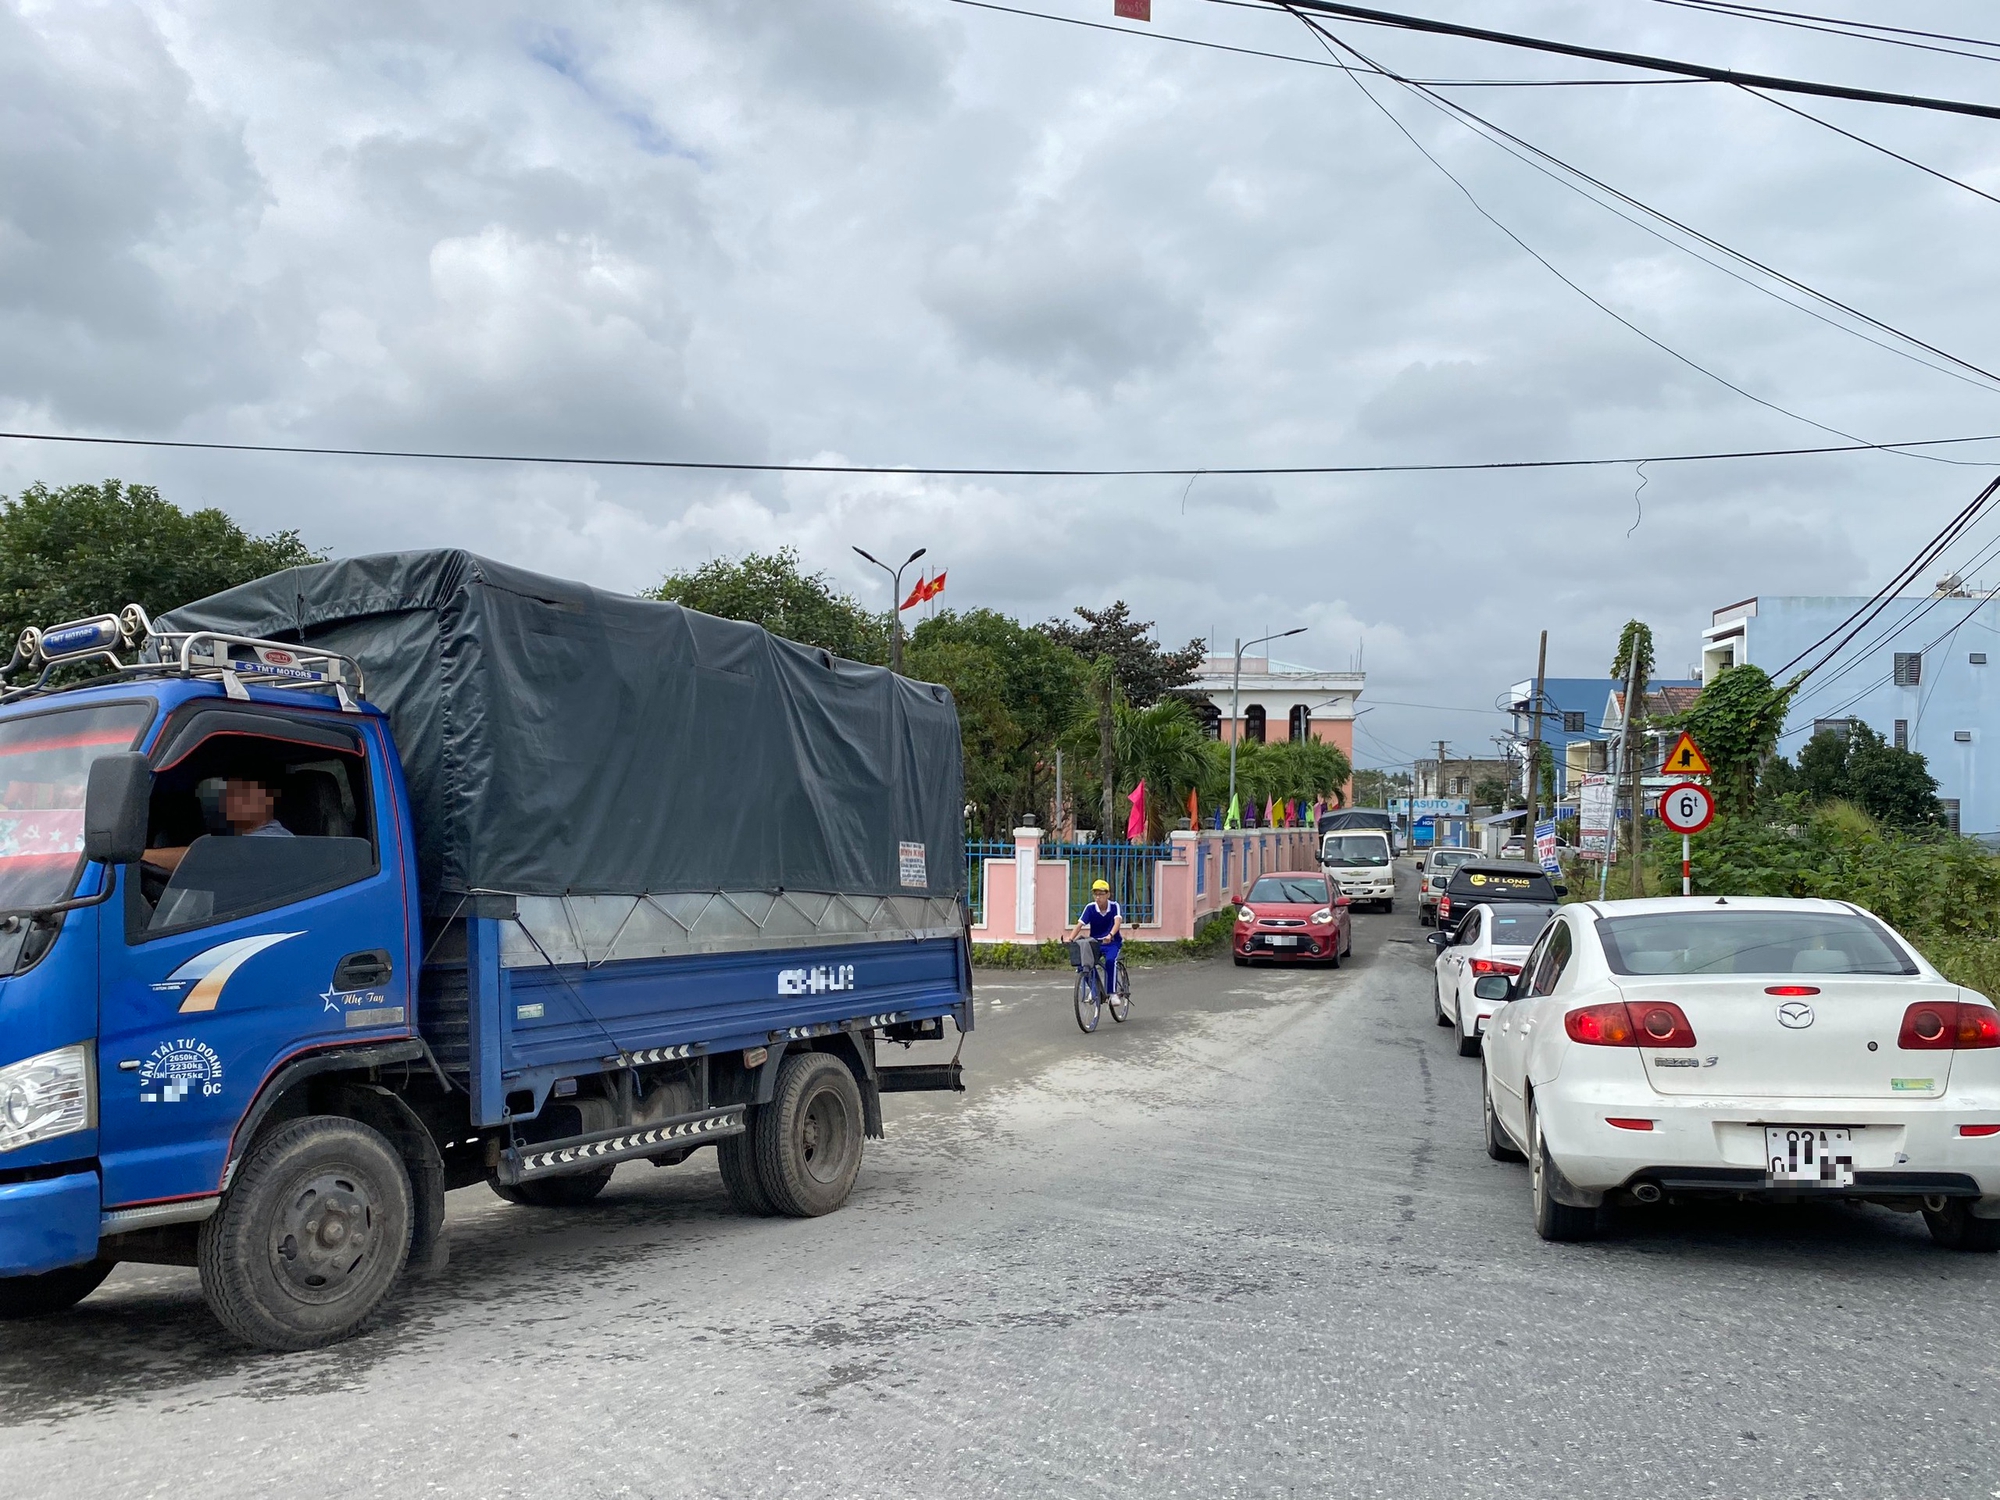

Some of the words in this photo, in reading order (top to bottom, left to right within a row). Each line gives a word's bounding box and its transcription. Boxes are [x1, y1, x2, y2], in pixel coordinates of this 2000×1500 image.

[51, 634, 64, 643] TMT
[65, 628, 93, 639] MOTORS
[256, 665, 274, 673] TMT
[276, 668, 312, 679] MOTORS
[1540, 846, 1556, 858] 100
[366, 992, 385, 1003] Tay
[151, 1041, 174, 1059] TẢI
[177, 1038, 196, 1049] TƯ
[197, 1042, 222, 1078] DOANH
[169, 1053, 198, 1062] 2650kg
[1702, 1055, 1719, 1067] 3
[169, 1062, 204, 1071] 2230kg
